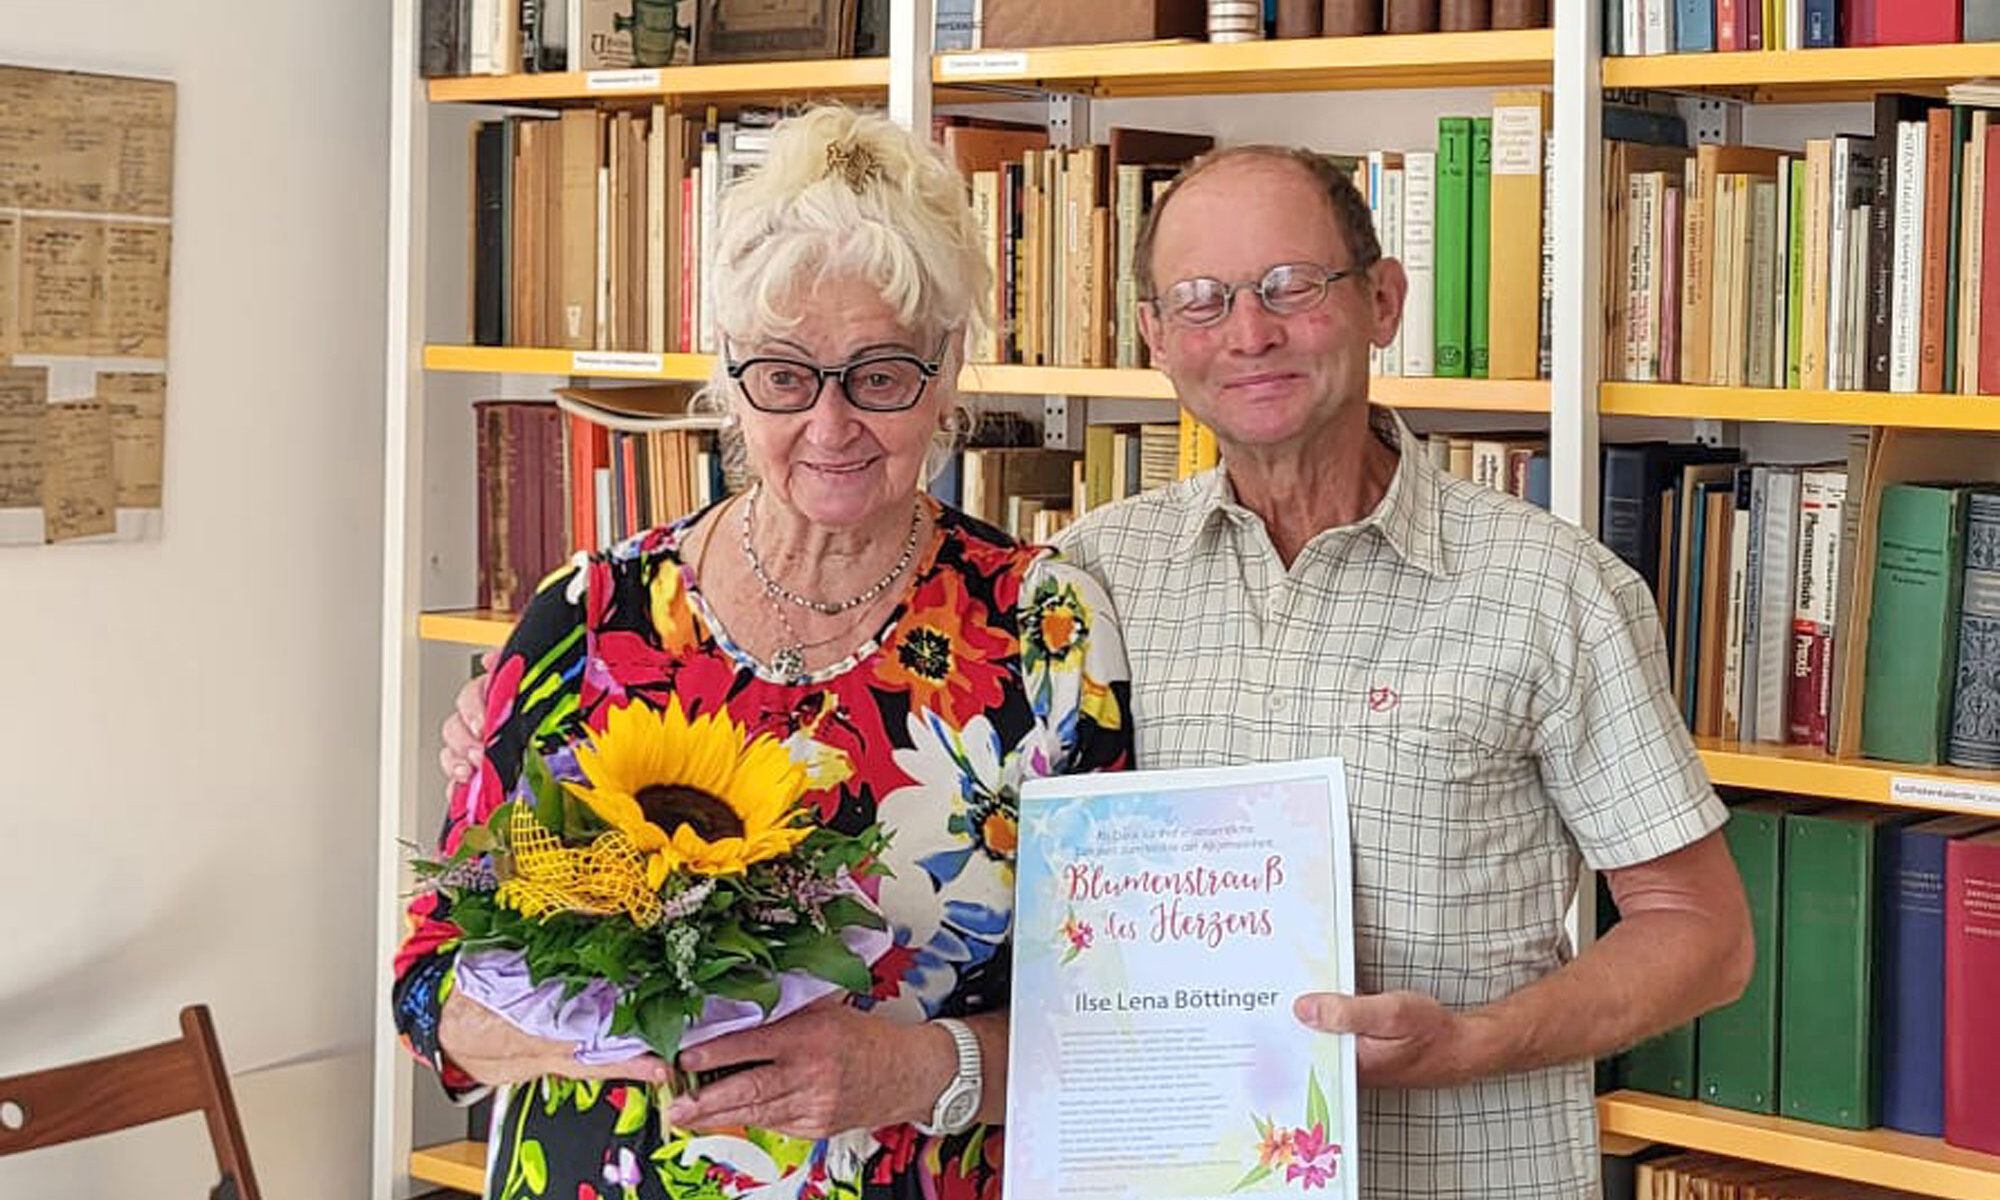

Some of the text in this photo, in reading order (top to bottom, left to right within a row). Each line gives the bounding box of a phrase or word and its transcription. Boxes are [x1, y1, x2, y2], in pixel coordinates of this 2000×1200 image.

[1795, 635, 1814, 678] Praxis
[1064, 855, 1283, 900] Blumenstrauß
[1105, 898, 1272, 948] des Herzens
[1075, 988, 1279, 1012] Ilse Lena Böttinger
